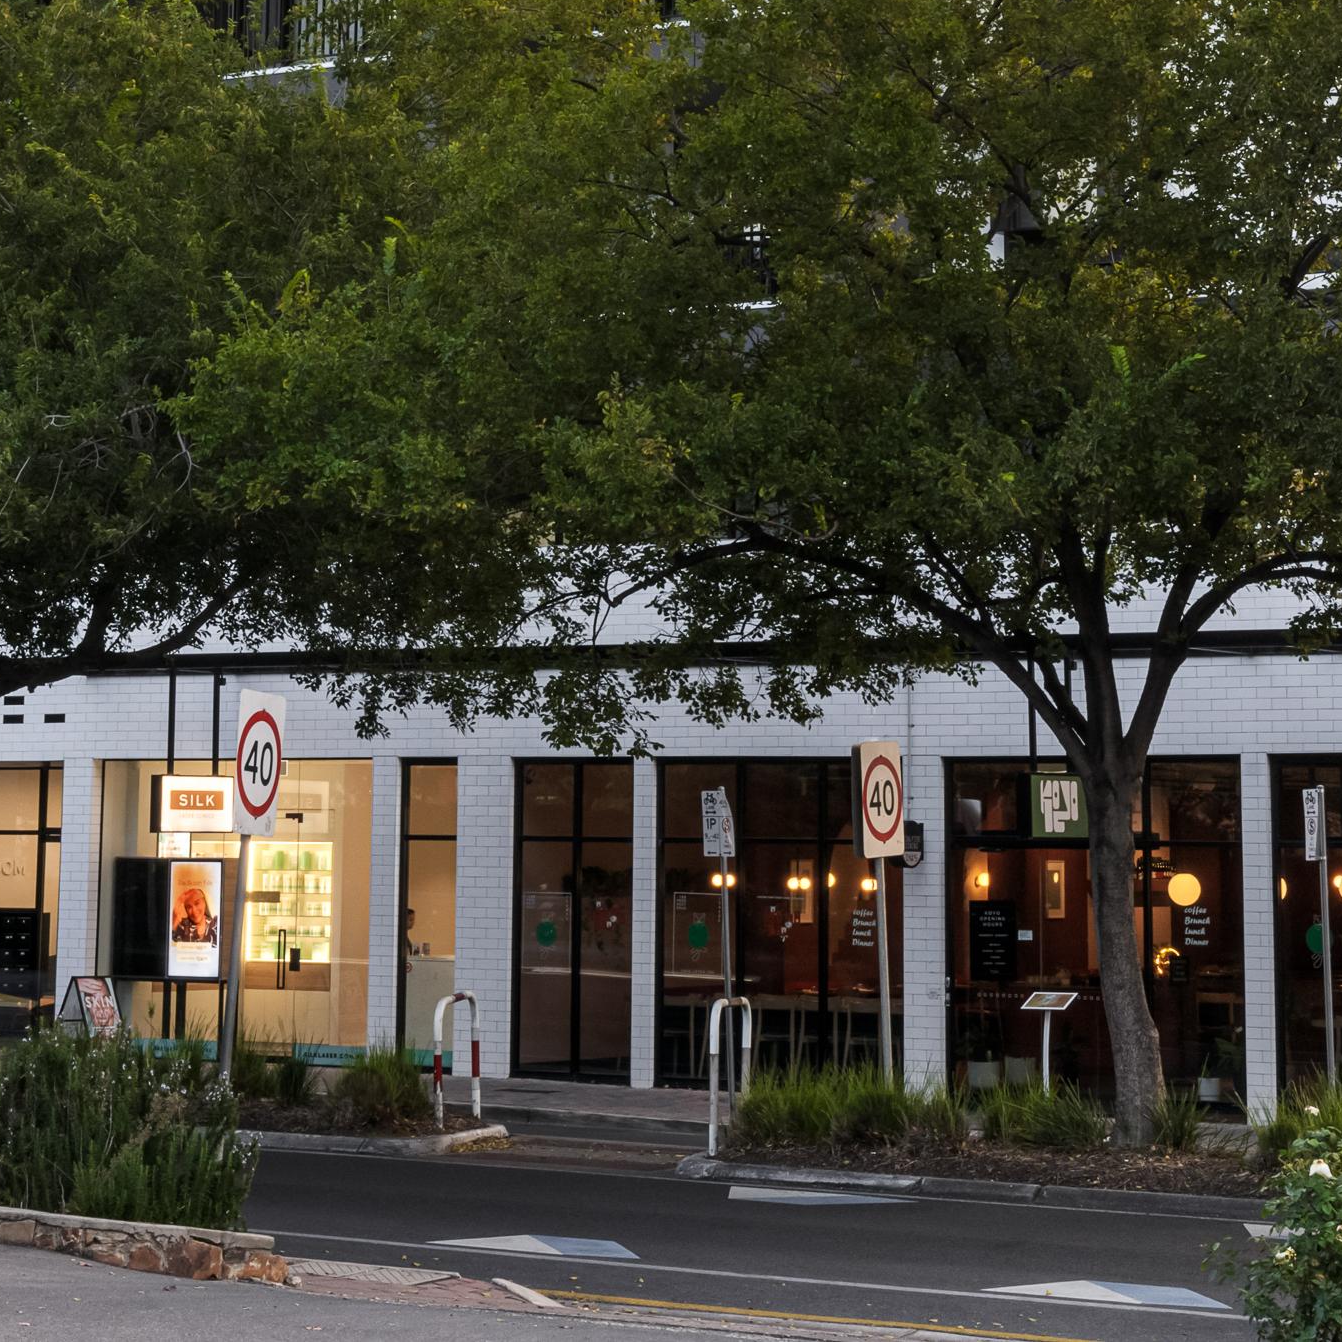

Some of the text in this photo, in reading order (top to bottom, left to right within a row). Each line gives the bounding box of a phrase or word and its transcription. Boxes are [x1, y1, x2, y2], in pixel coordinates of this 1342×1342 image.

[244, 740, 273, 786] 40
[178, 793, 215, 807] SILK
[869, 780, 895, 816] 40
[1184, 916, 1211, 925] Brunch
[1184, 927, 1206, 935] Lunch
[1184, 937, 1209, 946] Dinner
[85, 995, 114, 1009] SKIN
